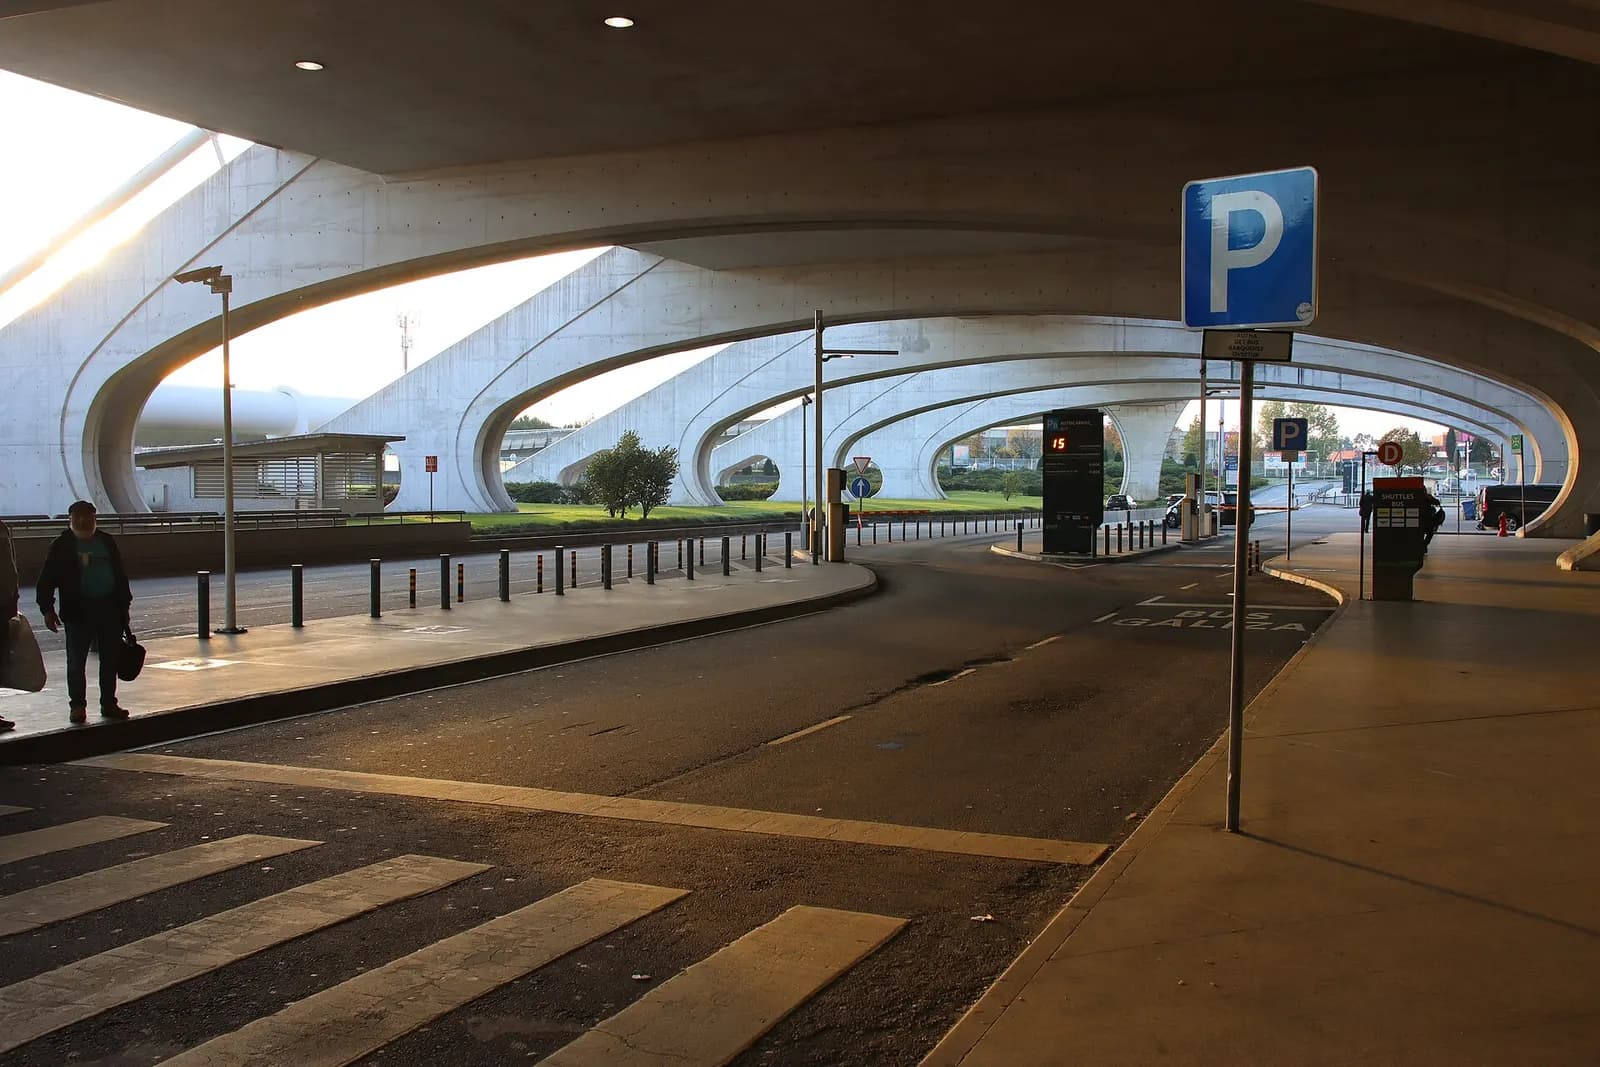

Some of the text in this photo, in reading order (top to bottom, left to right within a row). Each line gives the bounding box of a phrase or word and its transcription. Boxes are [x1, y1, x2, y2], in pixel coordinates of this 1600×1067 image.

[1210, 190, 1284, 313] P
[1280, 422, 1299, 448] P
[1052, 438, 1065, 449] 15
[1384, 447, 1399, 463] D
[1381, 493, 1414, 501] SHUTTLES
[1175, 610, 1273, 620] BUS
[1111, 617, 1306, 632] GALIZA
